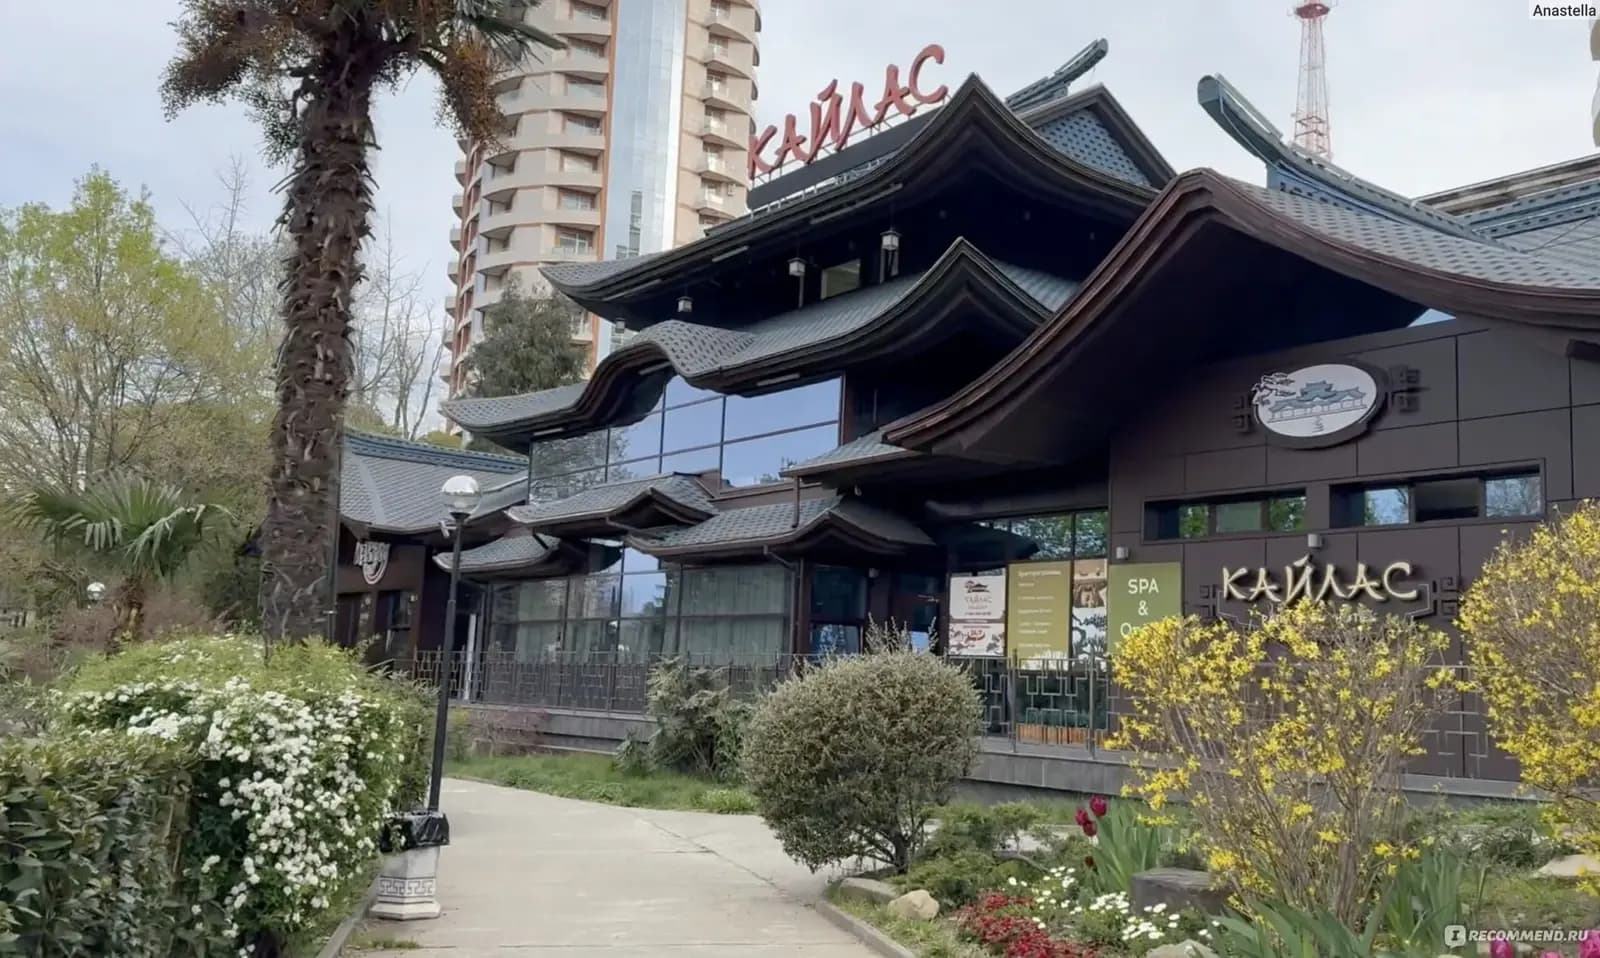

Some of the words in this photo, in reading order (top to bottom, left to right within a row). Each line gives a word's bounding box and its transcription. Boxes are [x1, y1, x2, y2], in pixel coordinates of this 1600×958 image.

[747, 44, 949, 180] КАЙЛАС
[1127, 578, 1159, 594] SPA
[1222, 553, 1418, 603] КАЙЛАС
[1138, 600, 1149, 616] &
